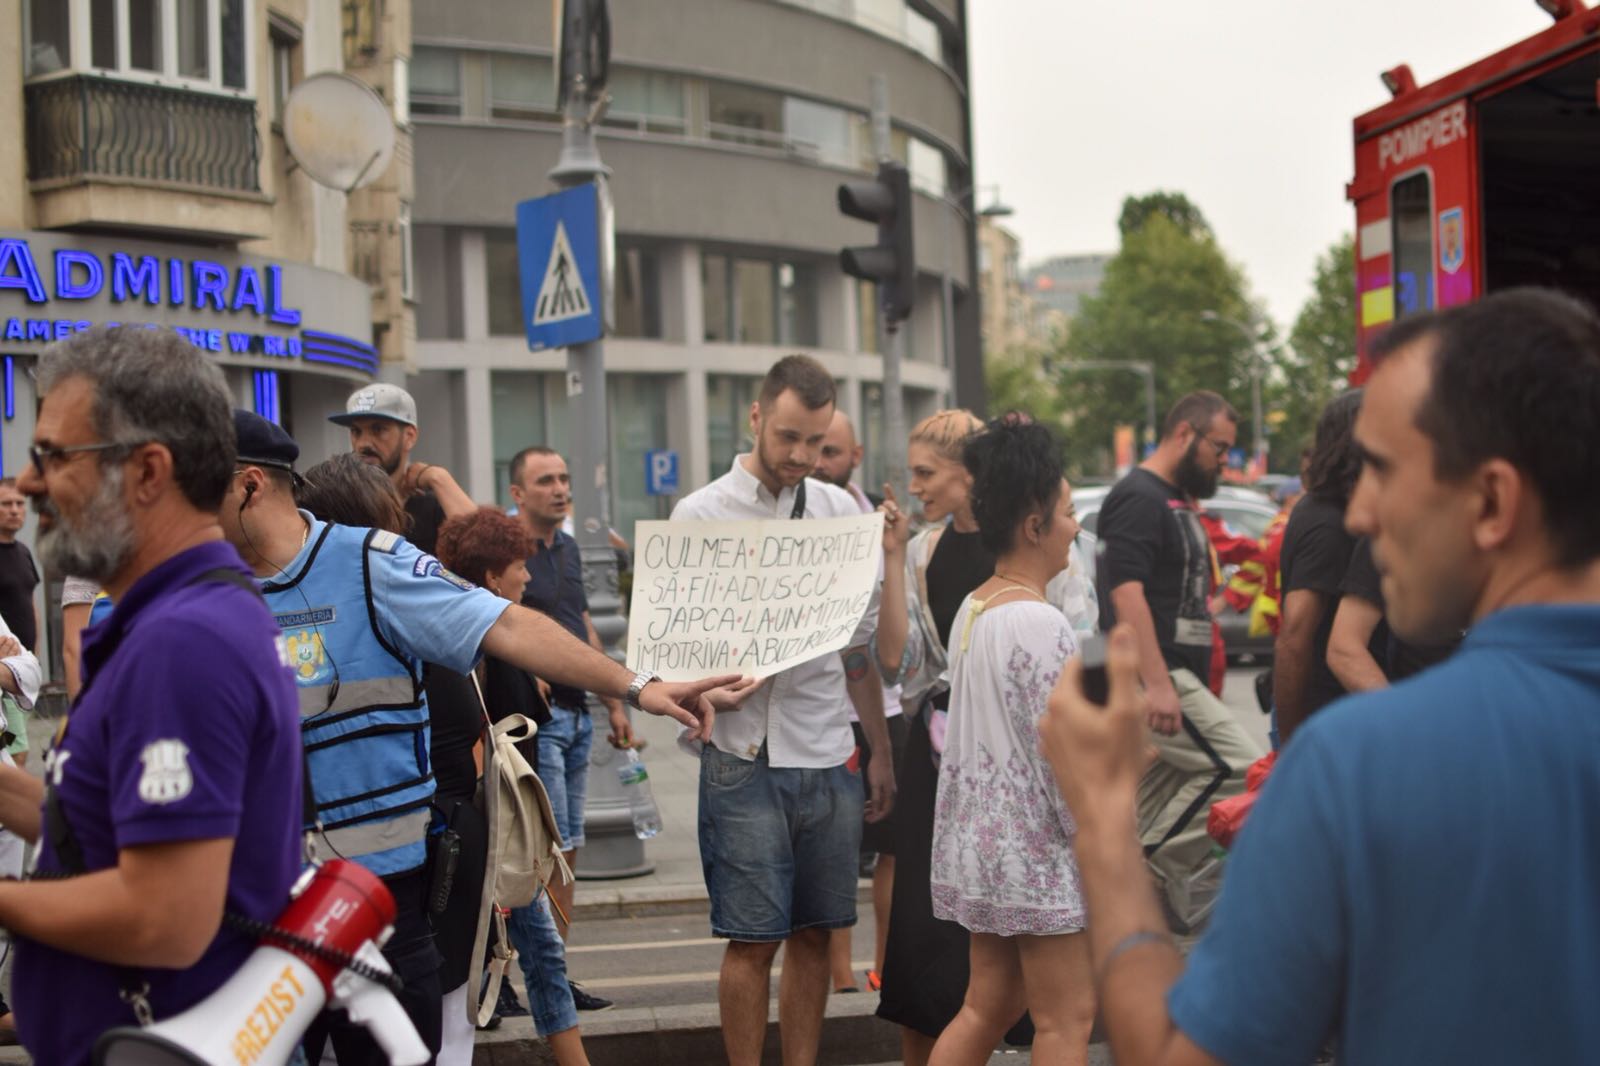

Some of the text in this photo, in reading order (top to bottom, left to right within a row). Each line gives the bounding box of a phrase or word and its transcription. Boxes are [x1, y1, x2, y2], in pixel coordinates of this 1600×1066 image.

[1378, 101, 1468, 171] POMPIER
[0, 238, 301, 326] ADMIRAL
[652, 453, 672, 490] P
[644, 533, 748, 570] CULMEA
[722, 574, 792, 603] ADUS
[796, 570, 836, 598] CU
[648, 590, 871, 641] JAPCA LA UN MITING
[635, 616, 860, 672] IMPOTRIVA ABUZURILOR
